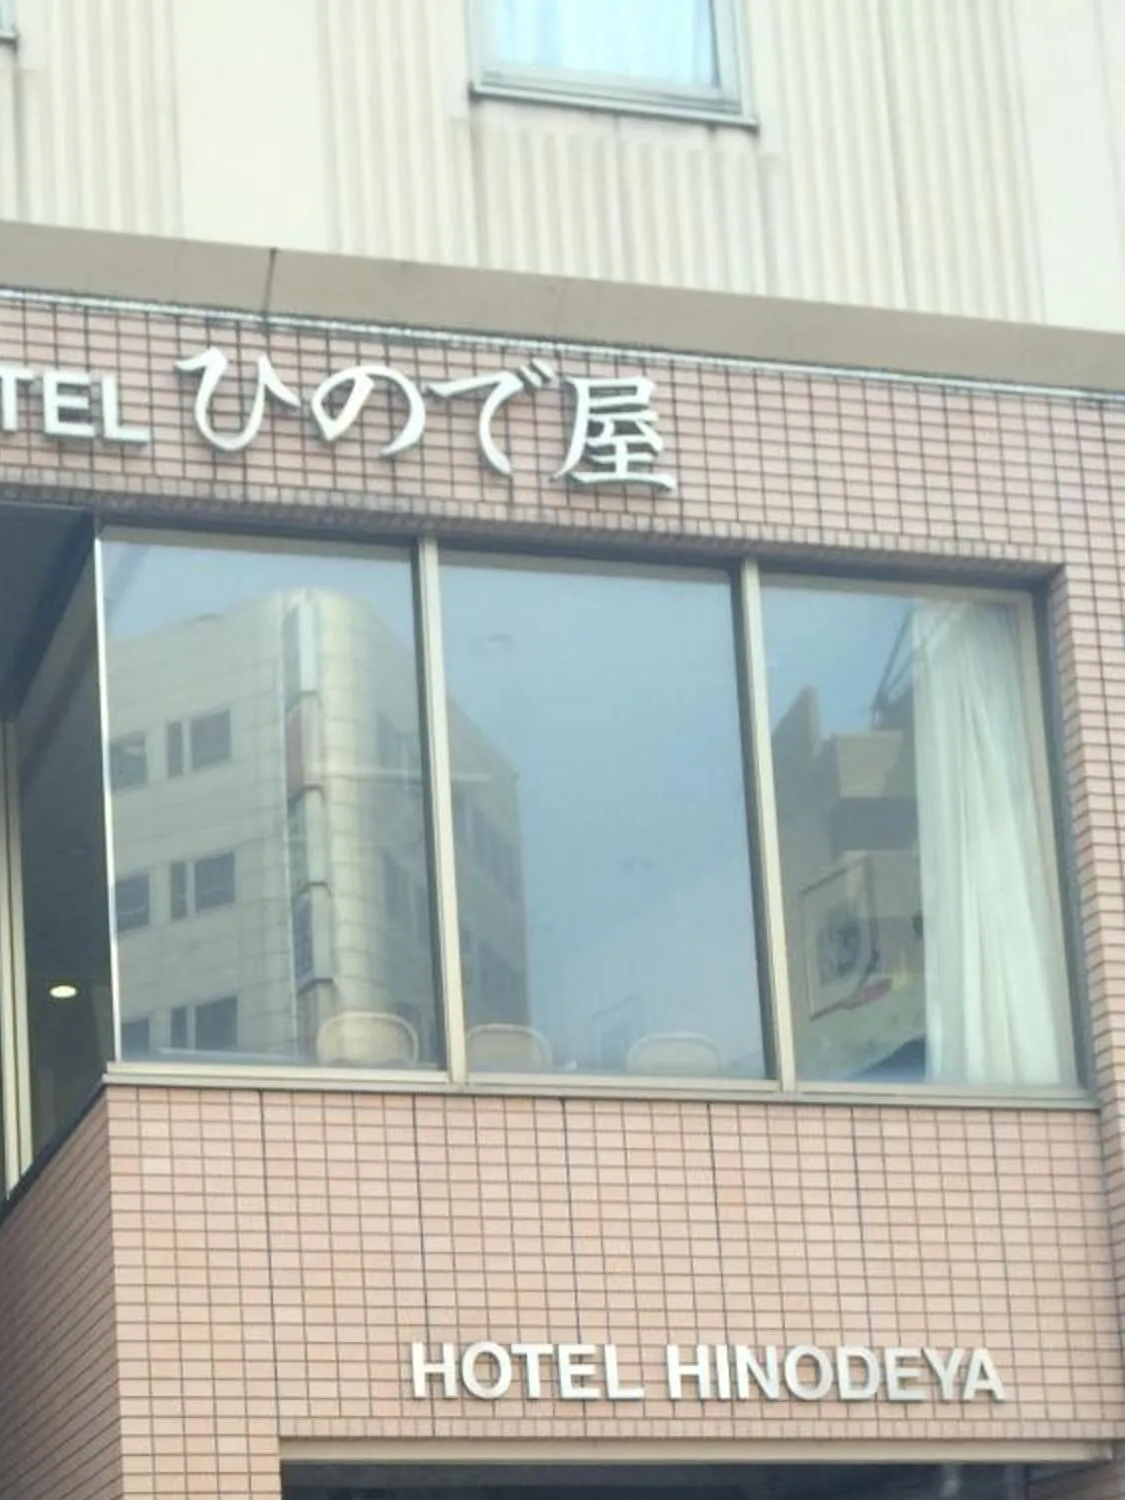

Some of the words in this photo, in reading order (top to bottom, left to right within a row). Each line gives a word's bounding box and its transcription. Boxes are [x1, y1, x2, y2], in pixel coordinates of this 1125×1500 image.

[176, 346, 676, 490] ひので屋
[410, 1340, 644, 1400] HOTEL
[666, 1344, 1007, 1402] HINODEYA
